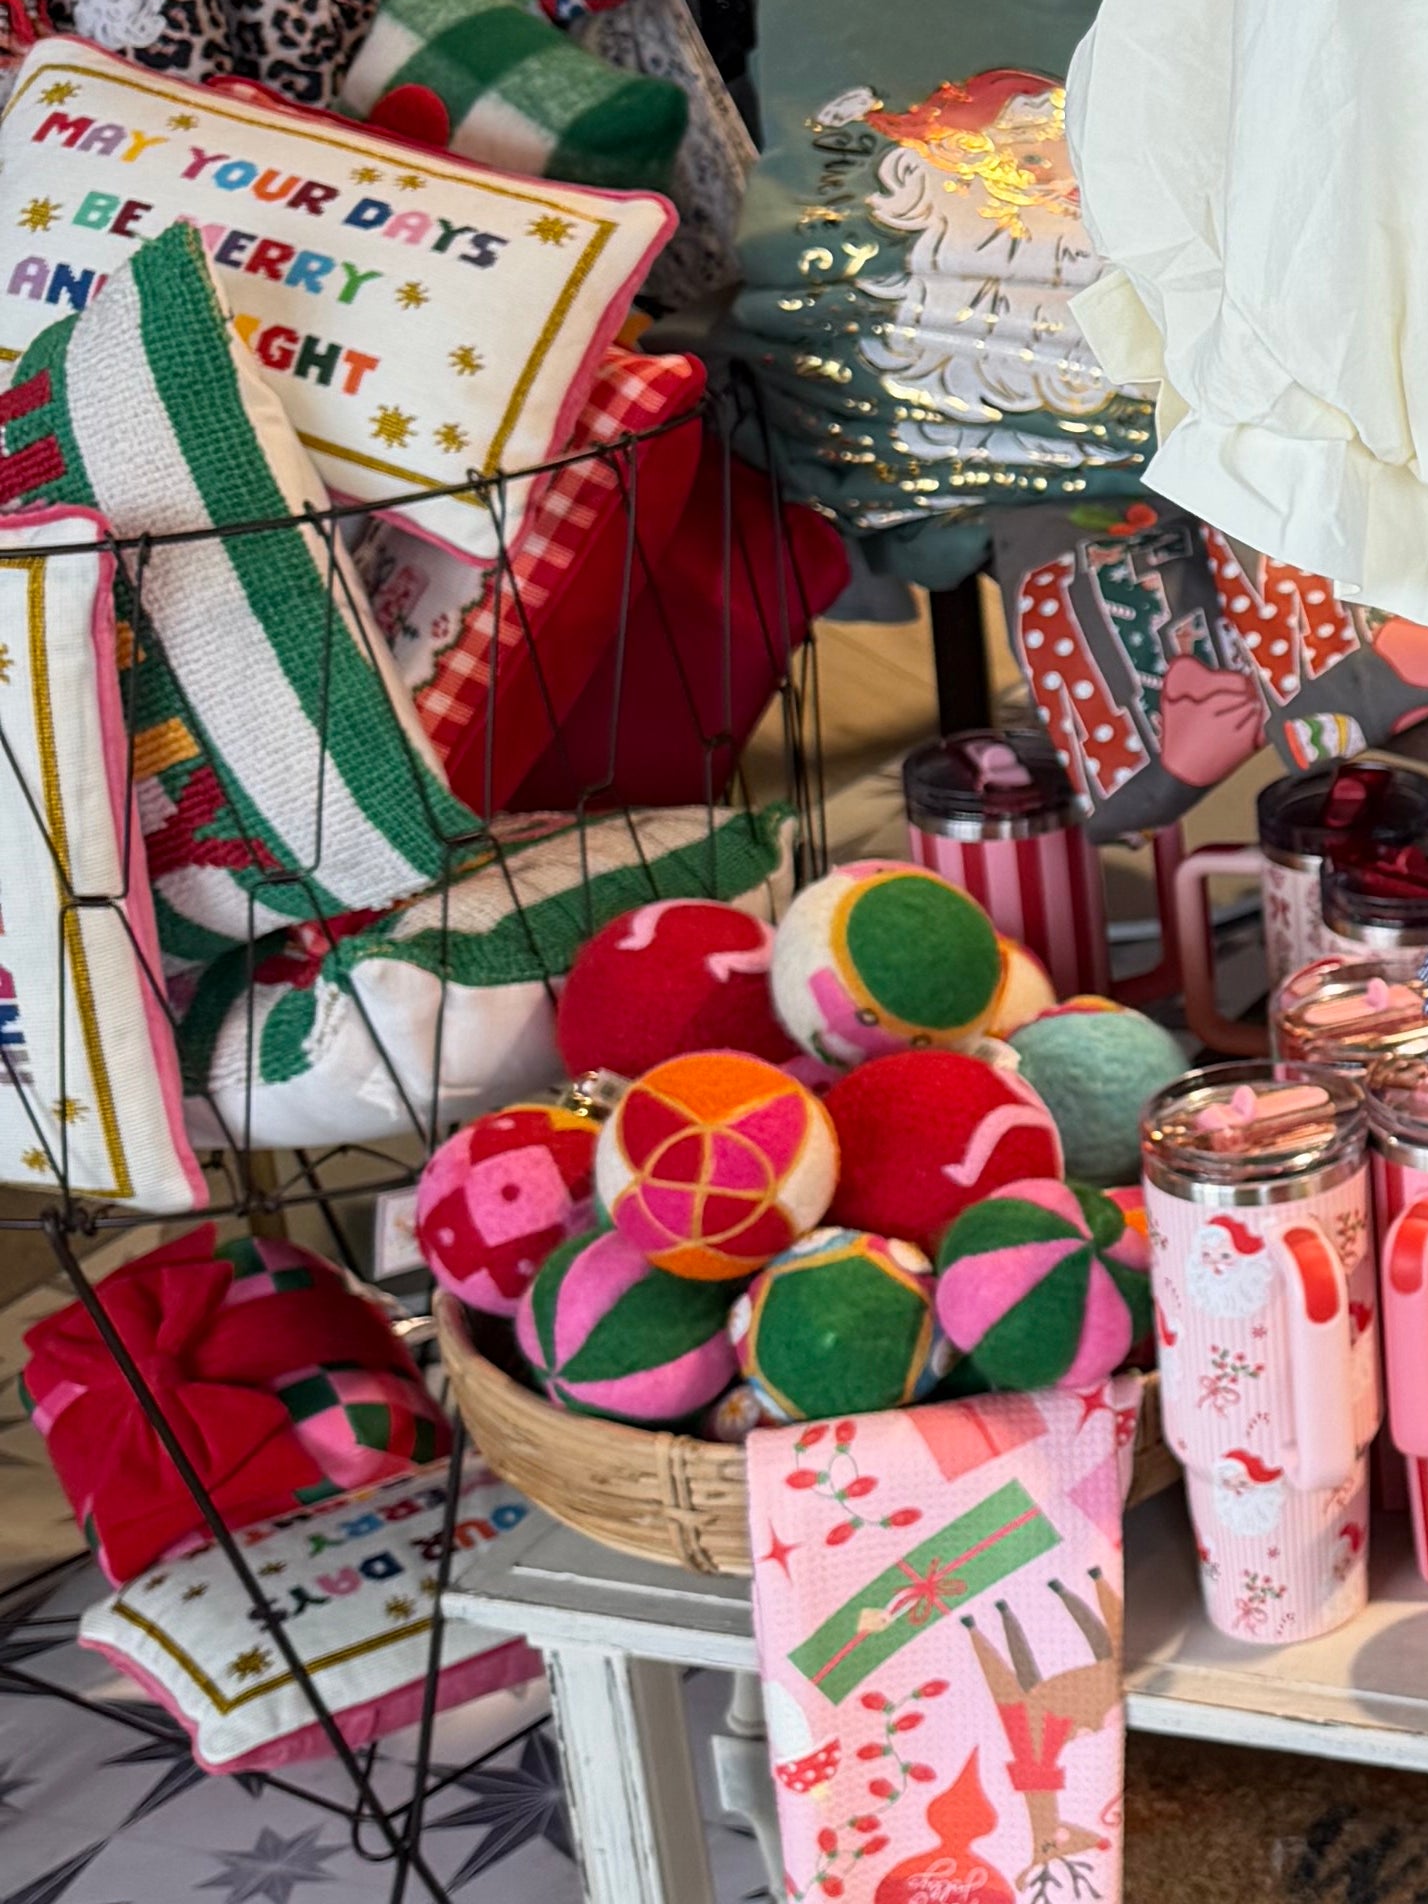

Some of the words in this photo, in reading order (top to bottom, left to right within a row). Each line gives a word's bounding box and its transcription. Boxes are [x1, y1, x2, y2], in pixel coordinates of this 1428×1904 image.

[32, 111, 168, 163] MAY
[180, 146, 340, 215] YOUR
[342, 197, 509, 270] DAYS
[71, 190, 154, 239] BE
[6, 255, 108, 312] AN
[232, 313, 382, 396] GHT
[411, 1502, 530, 1562] OUR
